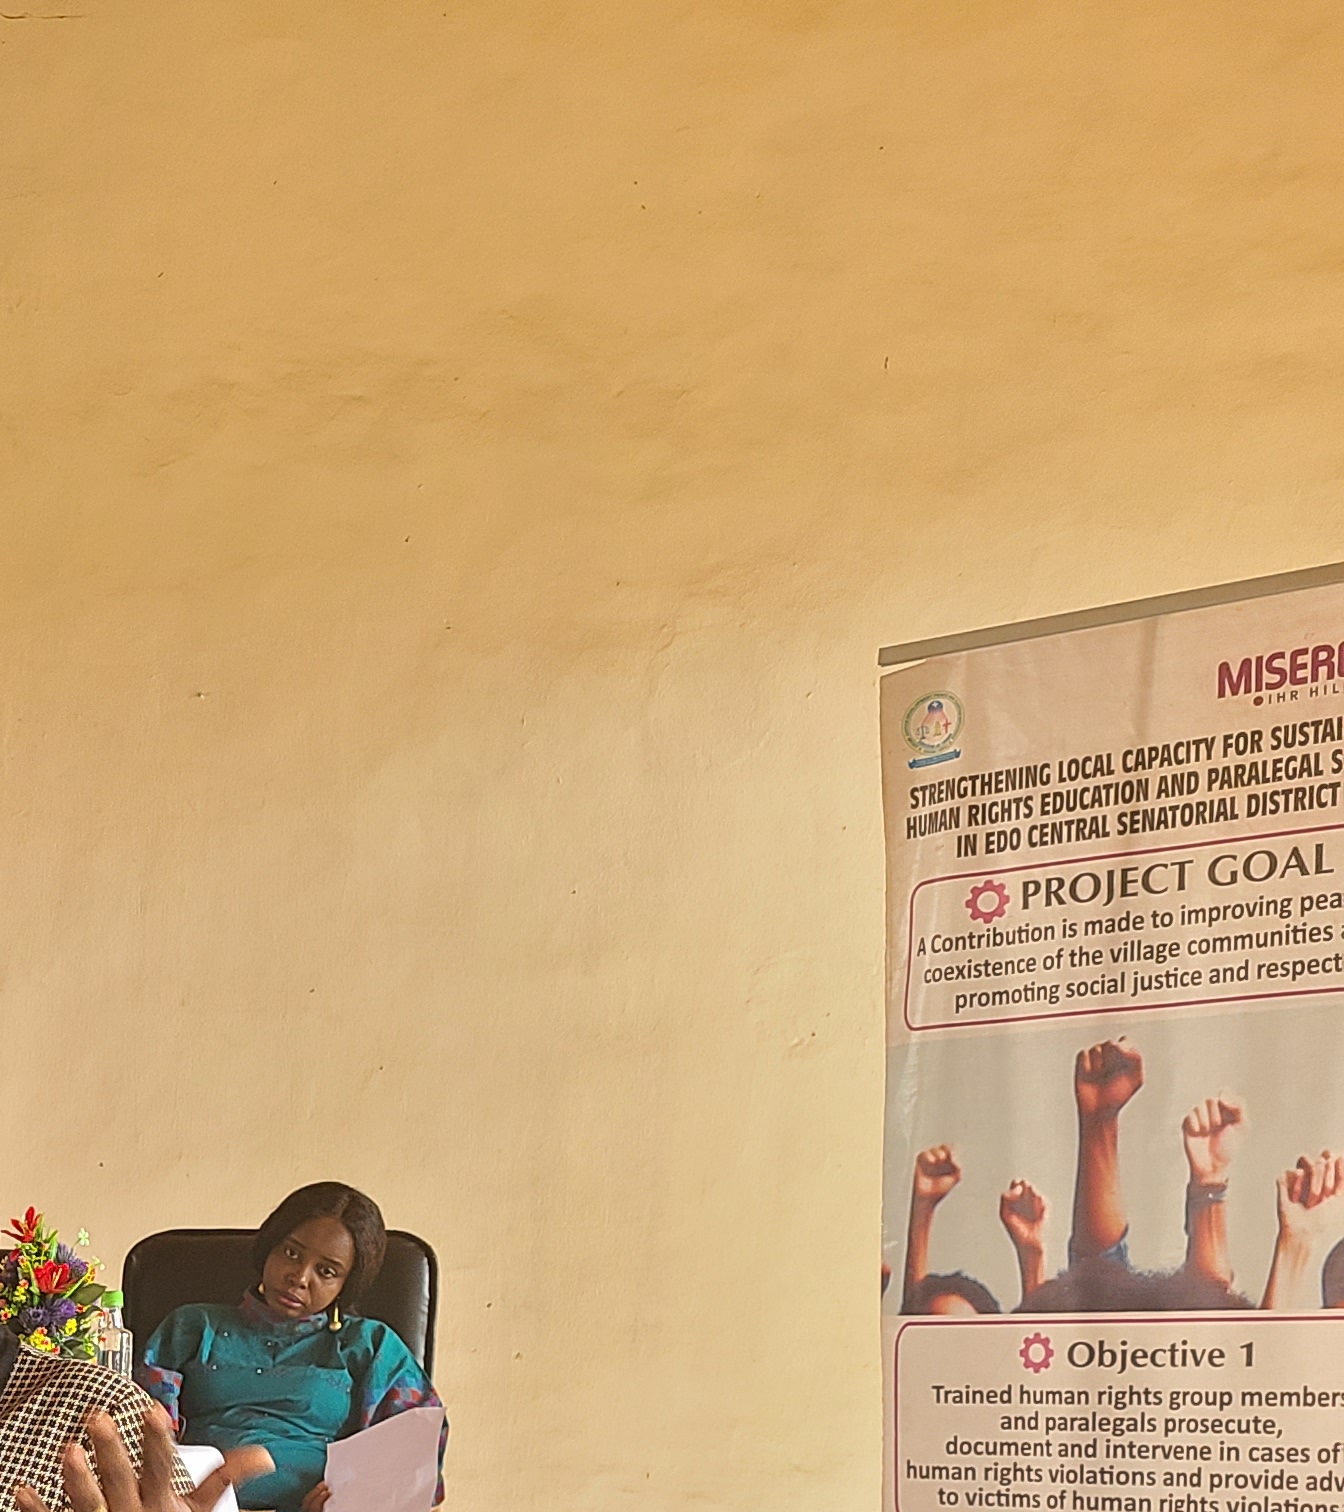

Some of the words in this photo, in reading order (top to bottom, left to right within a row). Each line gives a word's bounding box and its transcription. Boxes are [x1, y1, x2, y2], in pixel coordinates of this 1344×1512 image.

[906, 805, 961, 840] HUMAN
[967, 794, 1034, 828] RIGHTS
[1039, 777, 1150, 817] EDUCATION
[1155, 770, 1200, 801] AND
[1206, 751, 1325, 793] PARALEGAL
[909, 762, 1052, 810] STRENGTHENING
[1057, 752, 1116, 784] LOCAL
[1121, 735, 1217, 778] CAPACITY
[1221, 729, 1264, 759] FOR
[956, 832, 978, 859] IN
[984, 826, 1022, 856] EDO
[1027, 813, 1111, 849] CENTRAL
[1116, 795, 1240, 837] SENATORIAL
[1245, 780, 1342, 819] DISTRICT
[1021, 858, 1195, 911] PROJECT
[1207, 842, 1335, 887] GOAL
[916, 936, 927, 958] A
[930, 922, 1056, 954] Contribution
[1061, 917, 1079, 940] is
[1083, 909, 1145, 937] made
[1150, 909, 1174, 929] to
[1180, 894, 1294, 929] improving
[923, 956, 1037, 984] coexistence
[1042, 946, 1065, 971] of
[1067, 944, 1104, 969] the
[1108, 938, 1181, 965] village
[1186, 921, 1334, 956] communities
[954, 980, 1061, 1015] promoting
[1064, 970, 1126, 999] social
[1130, 966, 1203, 998] justice
[1208, 958, 1250, 985] and
[1066, 1339, 1226, 1375] Objective
[1239, 1341, 1254, 1368] 1
[931, 1383, 1013, 1405] Trained
[1018, 1383, 1090, 1406] human
[1097, 1384, 1164, 1411] rights
[1168, 1390, 1234, 1412] group
